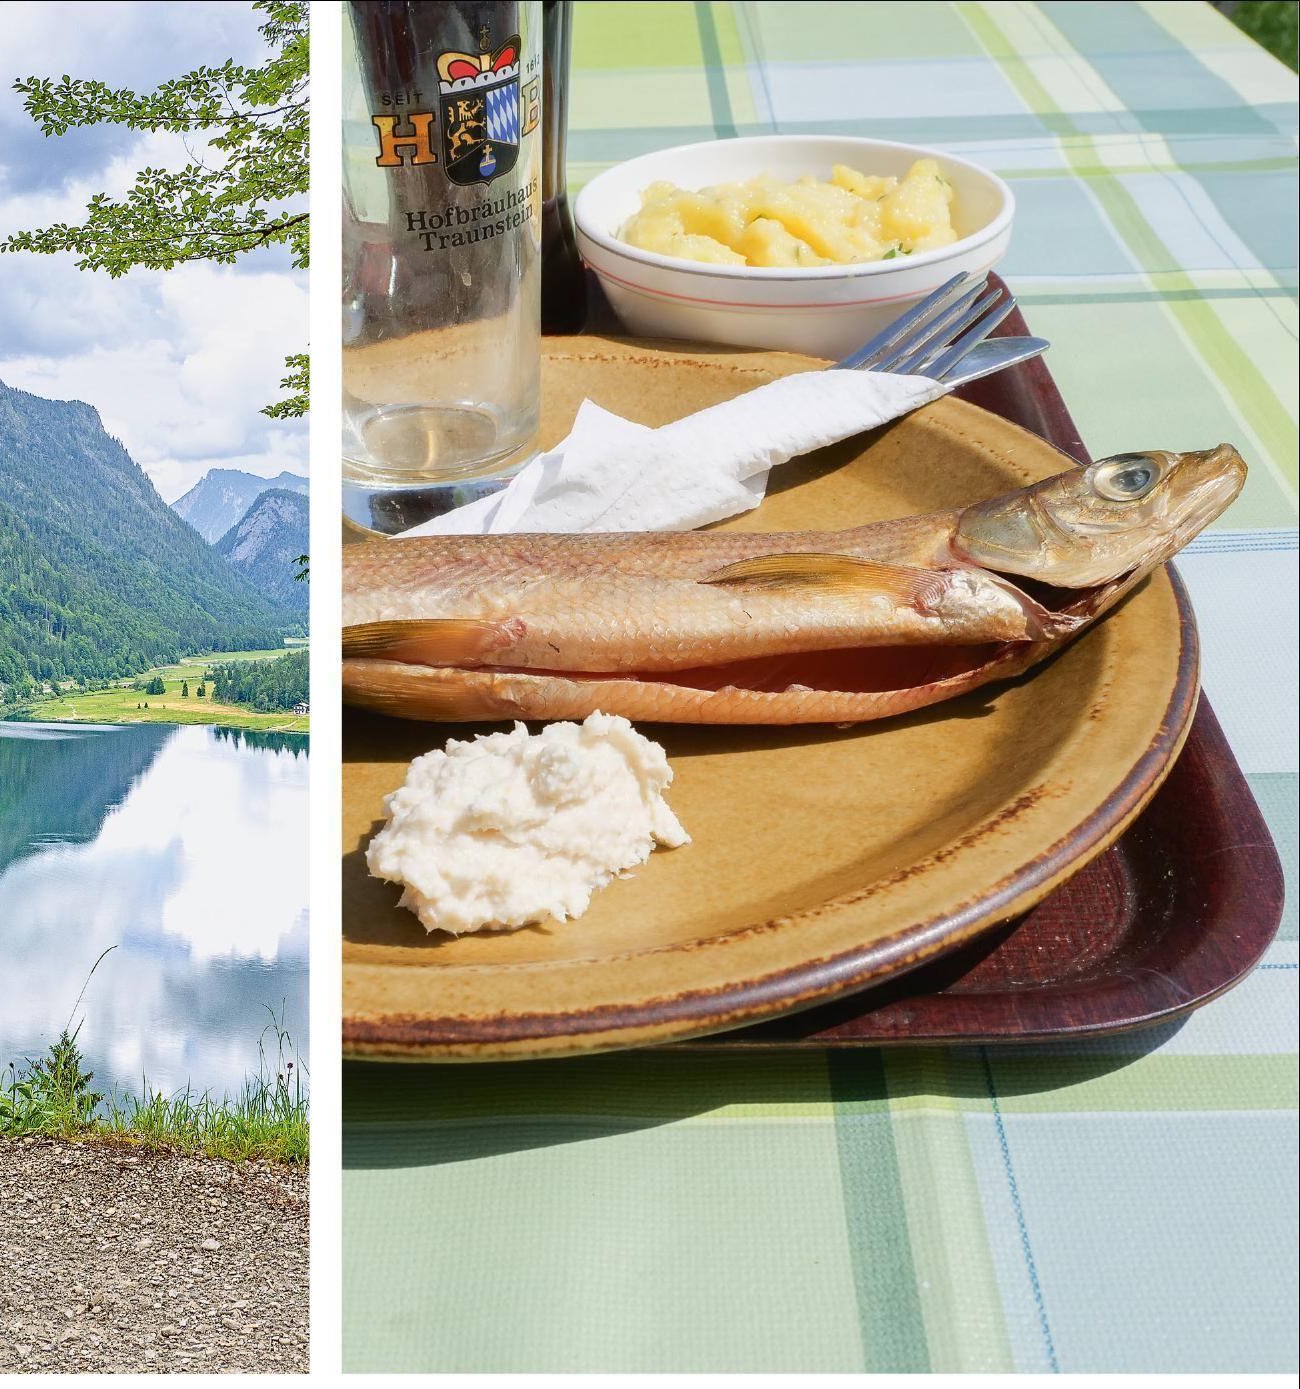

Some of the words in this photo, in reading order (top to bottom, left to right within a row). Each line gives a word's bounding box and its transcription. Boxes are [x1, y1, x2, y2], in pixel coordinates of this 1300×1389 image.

[382, 92, 423, 106] SEIT
[521, 74, 542, 138] B
[371, 112, 438, 167] H
[405, 176, 538, 232] Hofbräuhaus
[419, 203, 534, 252] Traunstein
